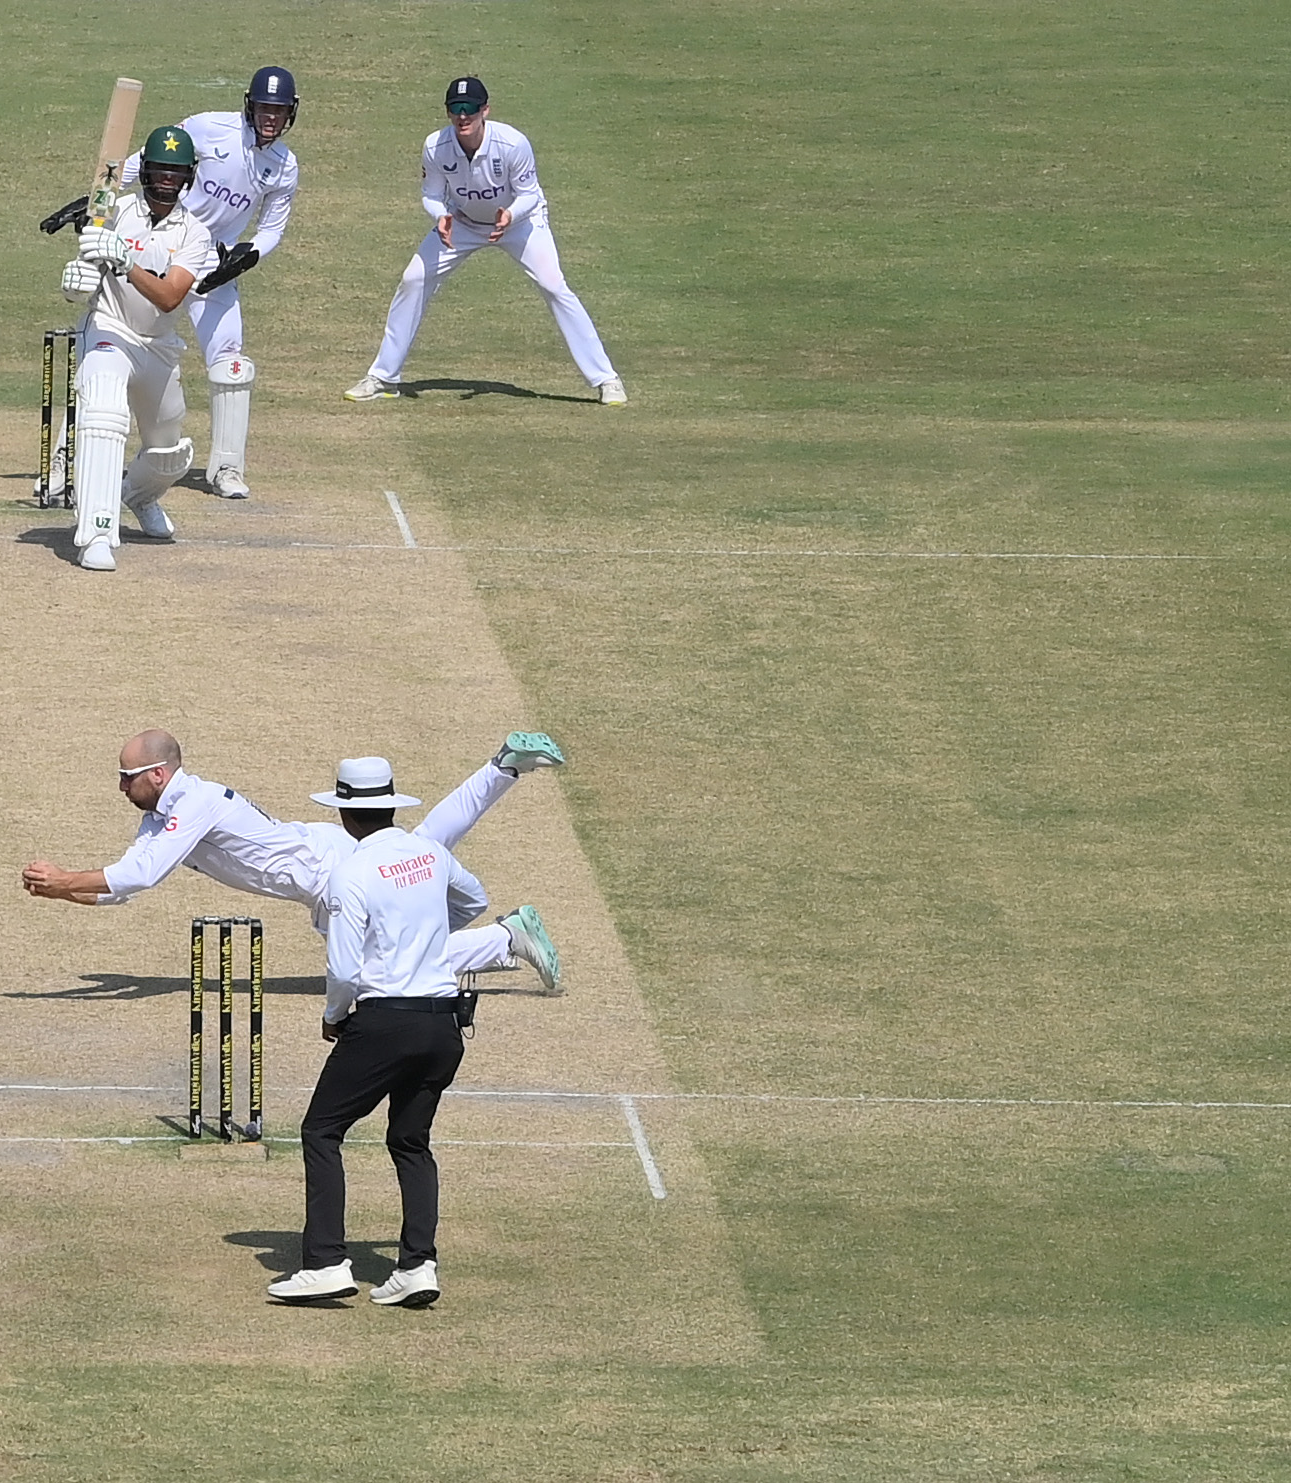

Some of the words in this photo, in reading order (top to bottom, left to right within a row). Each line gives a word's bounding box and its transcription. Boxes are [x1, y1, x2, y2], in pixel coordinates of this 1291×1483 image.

[203, 178, 251, 212] cinch
[456, 185, 505, 200] cnch
[95, 516, 112, 529] UZ
[164, 816, 178, 831] G
[378, 852, 436, 878] Emirates
[394, 876, 407, 890] FLY
[407, 867, 433, 886] BETTER
